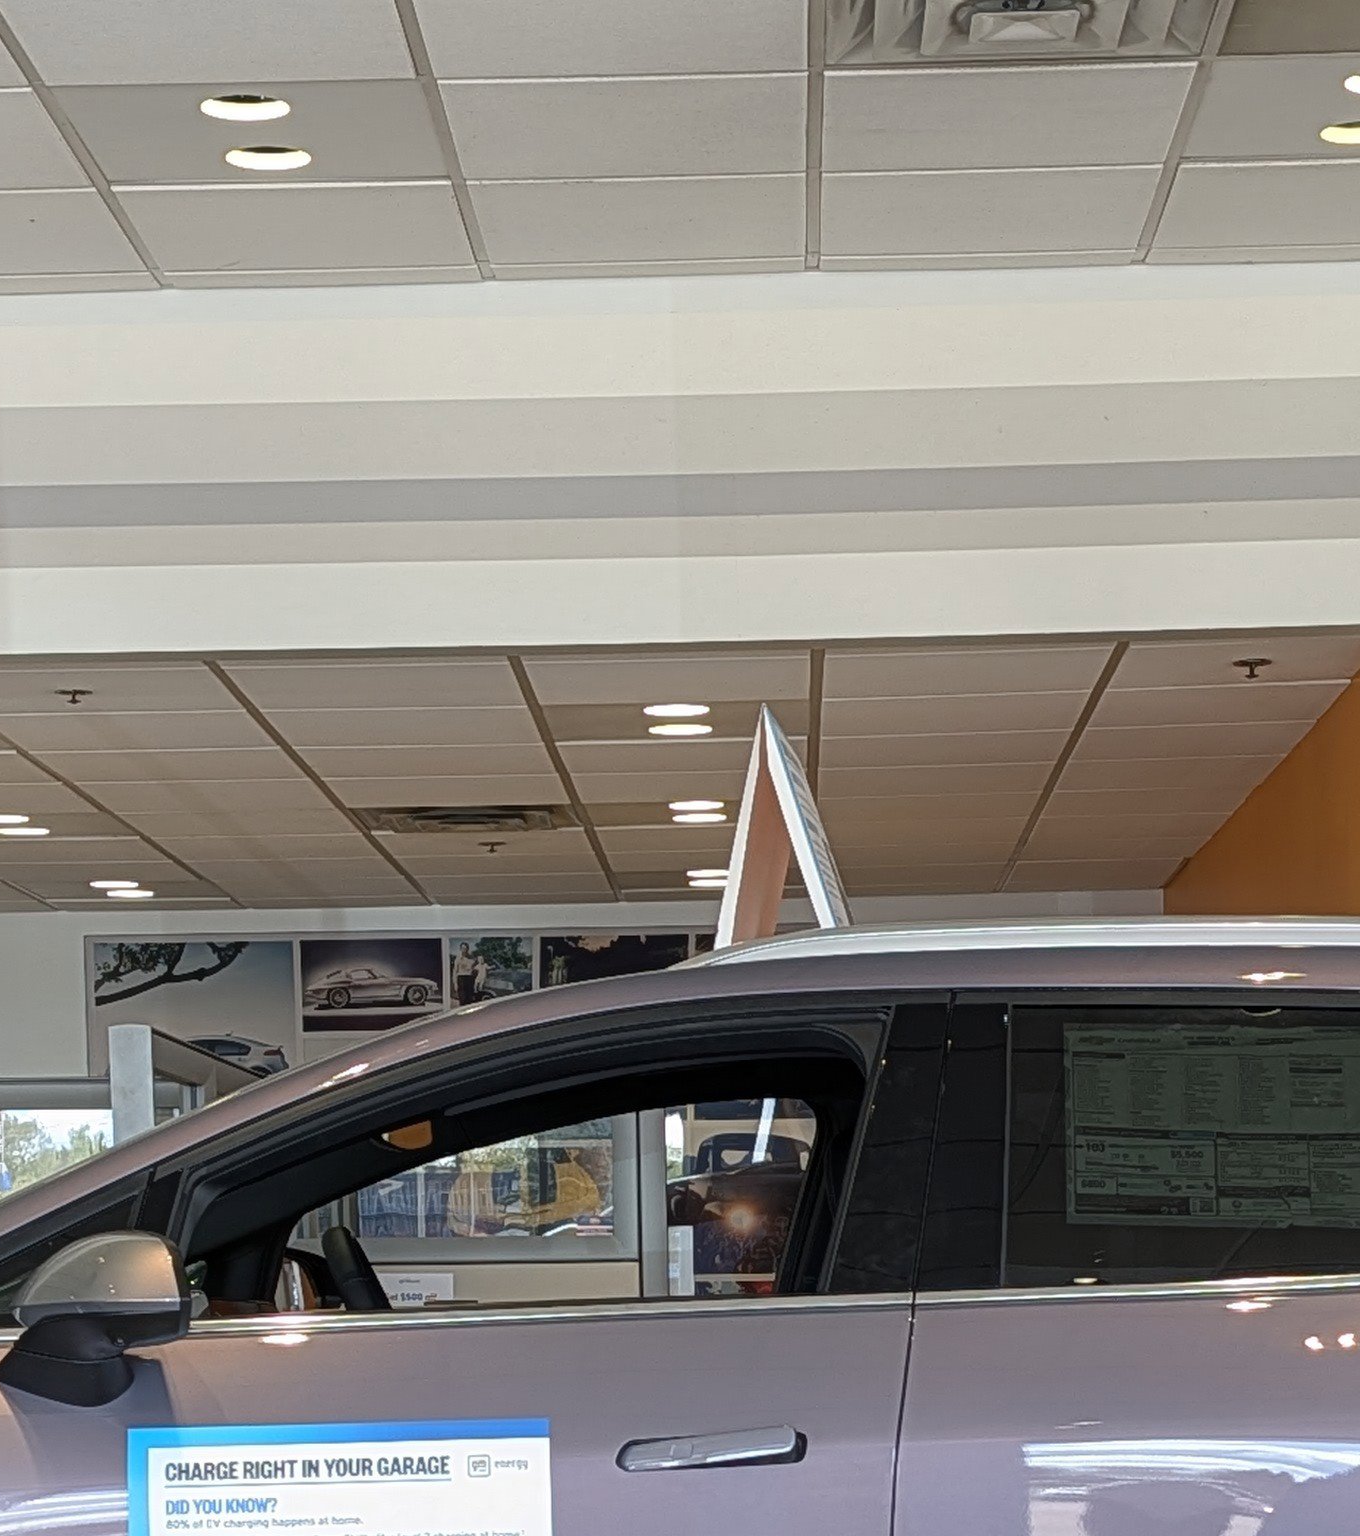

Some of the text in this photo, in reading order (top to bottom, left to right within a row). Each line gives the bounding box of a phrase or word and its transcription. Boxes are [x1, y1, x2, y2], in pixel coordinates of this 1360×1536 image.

[165, 1455, 450, 1482] CHARGE RIGHT IN YOUR GARAGE
[166, 1498, 278, 1515] DID YOU KNOW?
[224, 1518, 269, 1530] charging
[272, 1517, 315, 1528] happens
